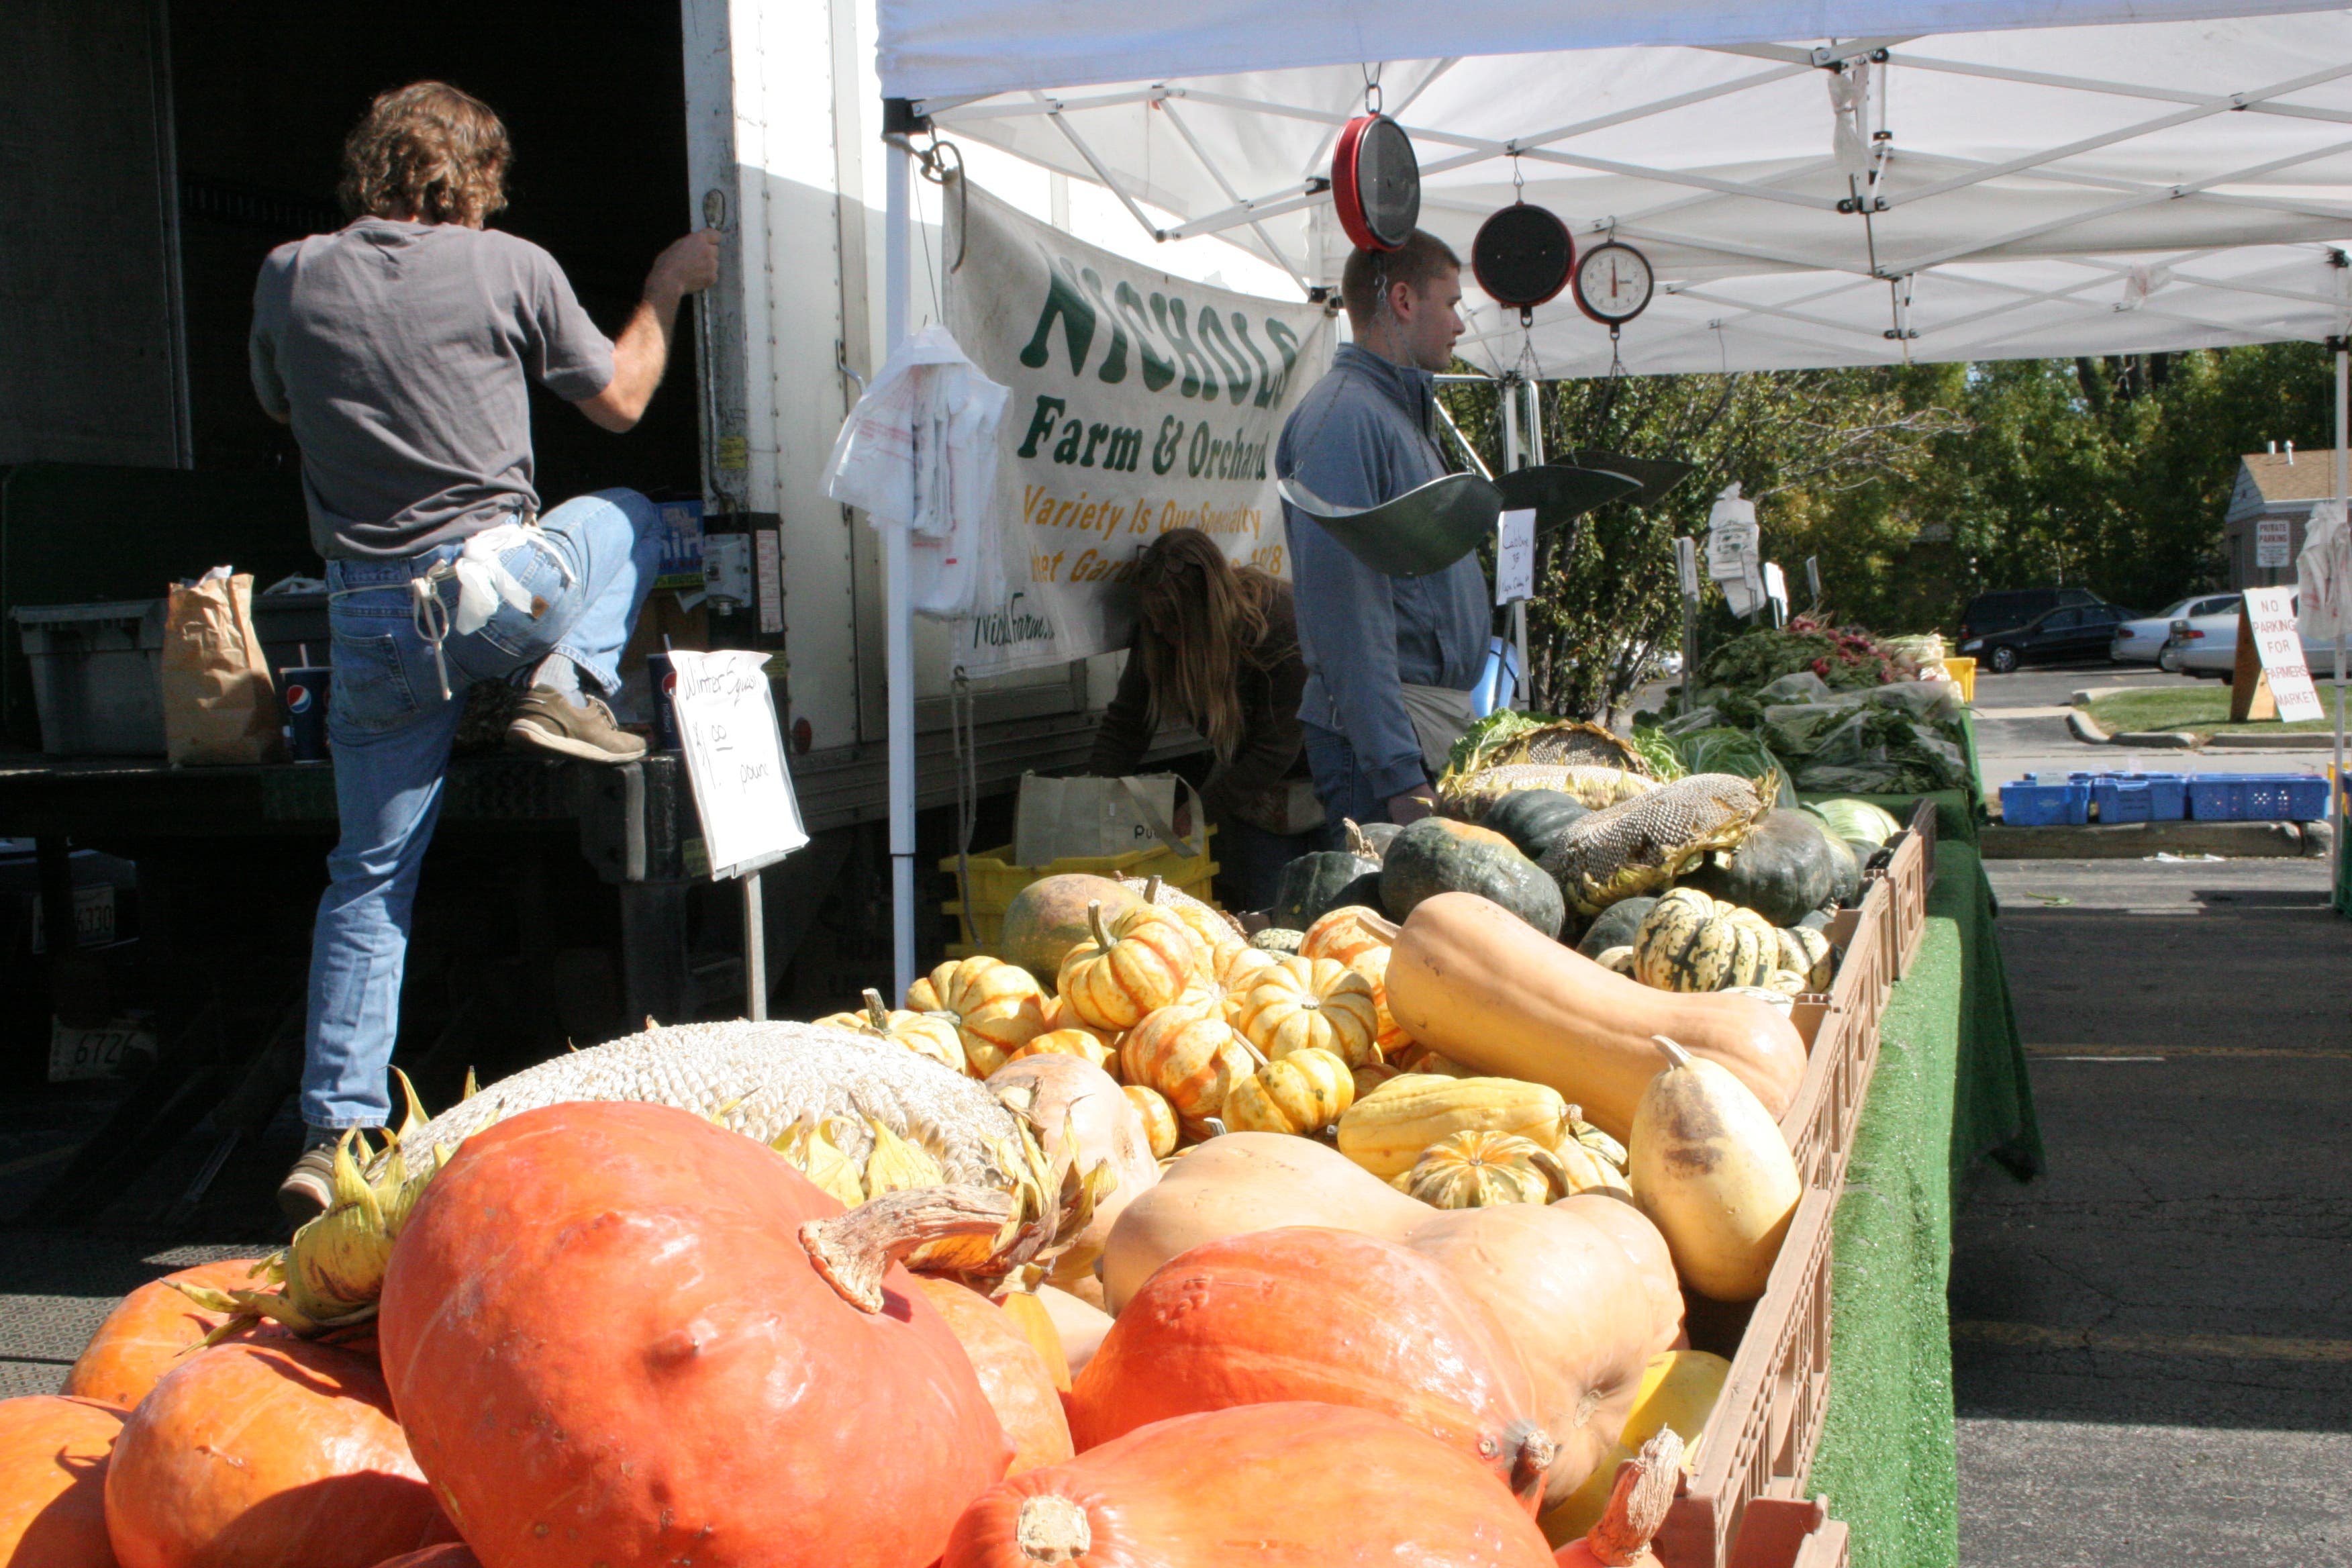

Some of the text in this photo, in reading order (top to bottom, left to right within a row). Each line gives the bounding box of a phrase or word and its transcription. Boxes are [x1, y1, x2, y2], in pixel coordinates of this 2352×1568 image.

[1020, 243, 1299, 411] NICHOLS
[1017, 394, 1267, 482] Farm & Orchard
[1024, 484, 1262, 540] Variety Is Our Specialty
[1070, 548, 1142, 583] Gard
[2261, 599, 2279, 613] NO
[2252, 620, 2296, 634] PARKING
[2267, 640, 2291, 654] FOR
[681, 657, 725, 701] Winter
[2265, 665, 2309, 680] FARMERS
[2274, 691, 2315, 707] MARKET
